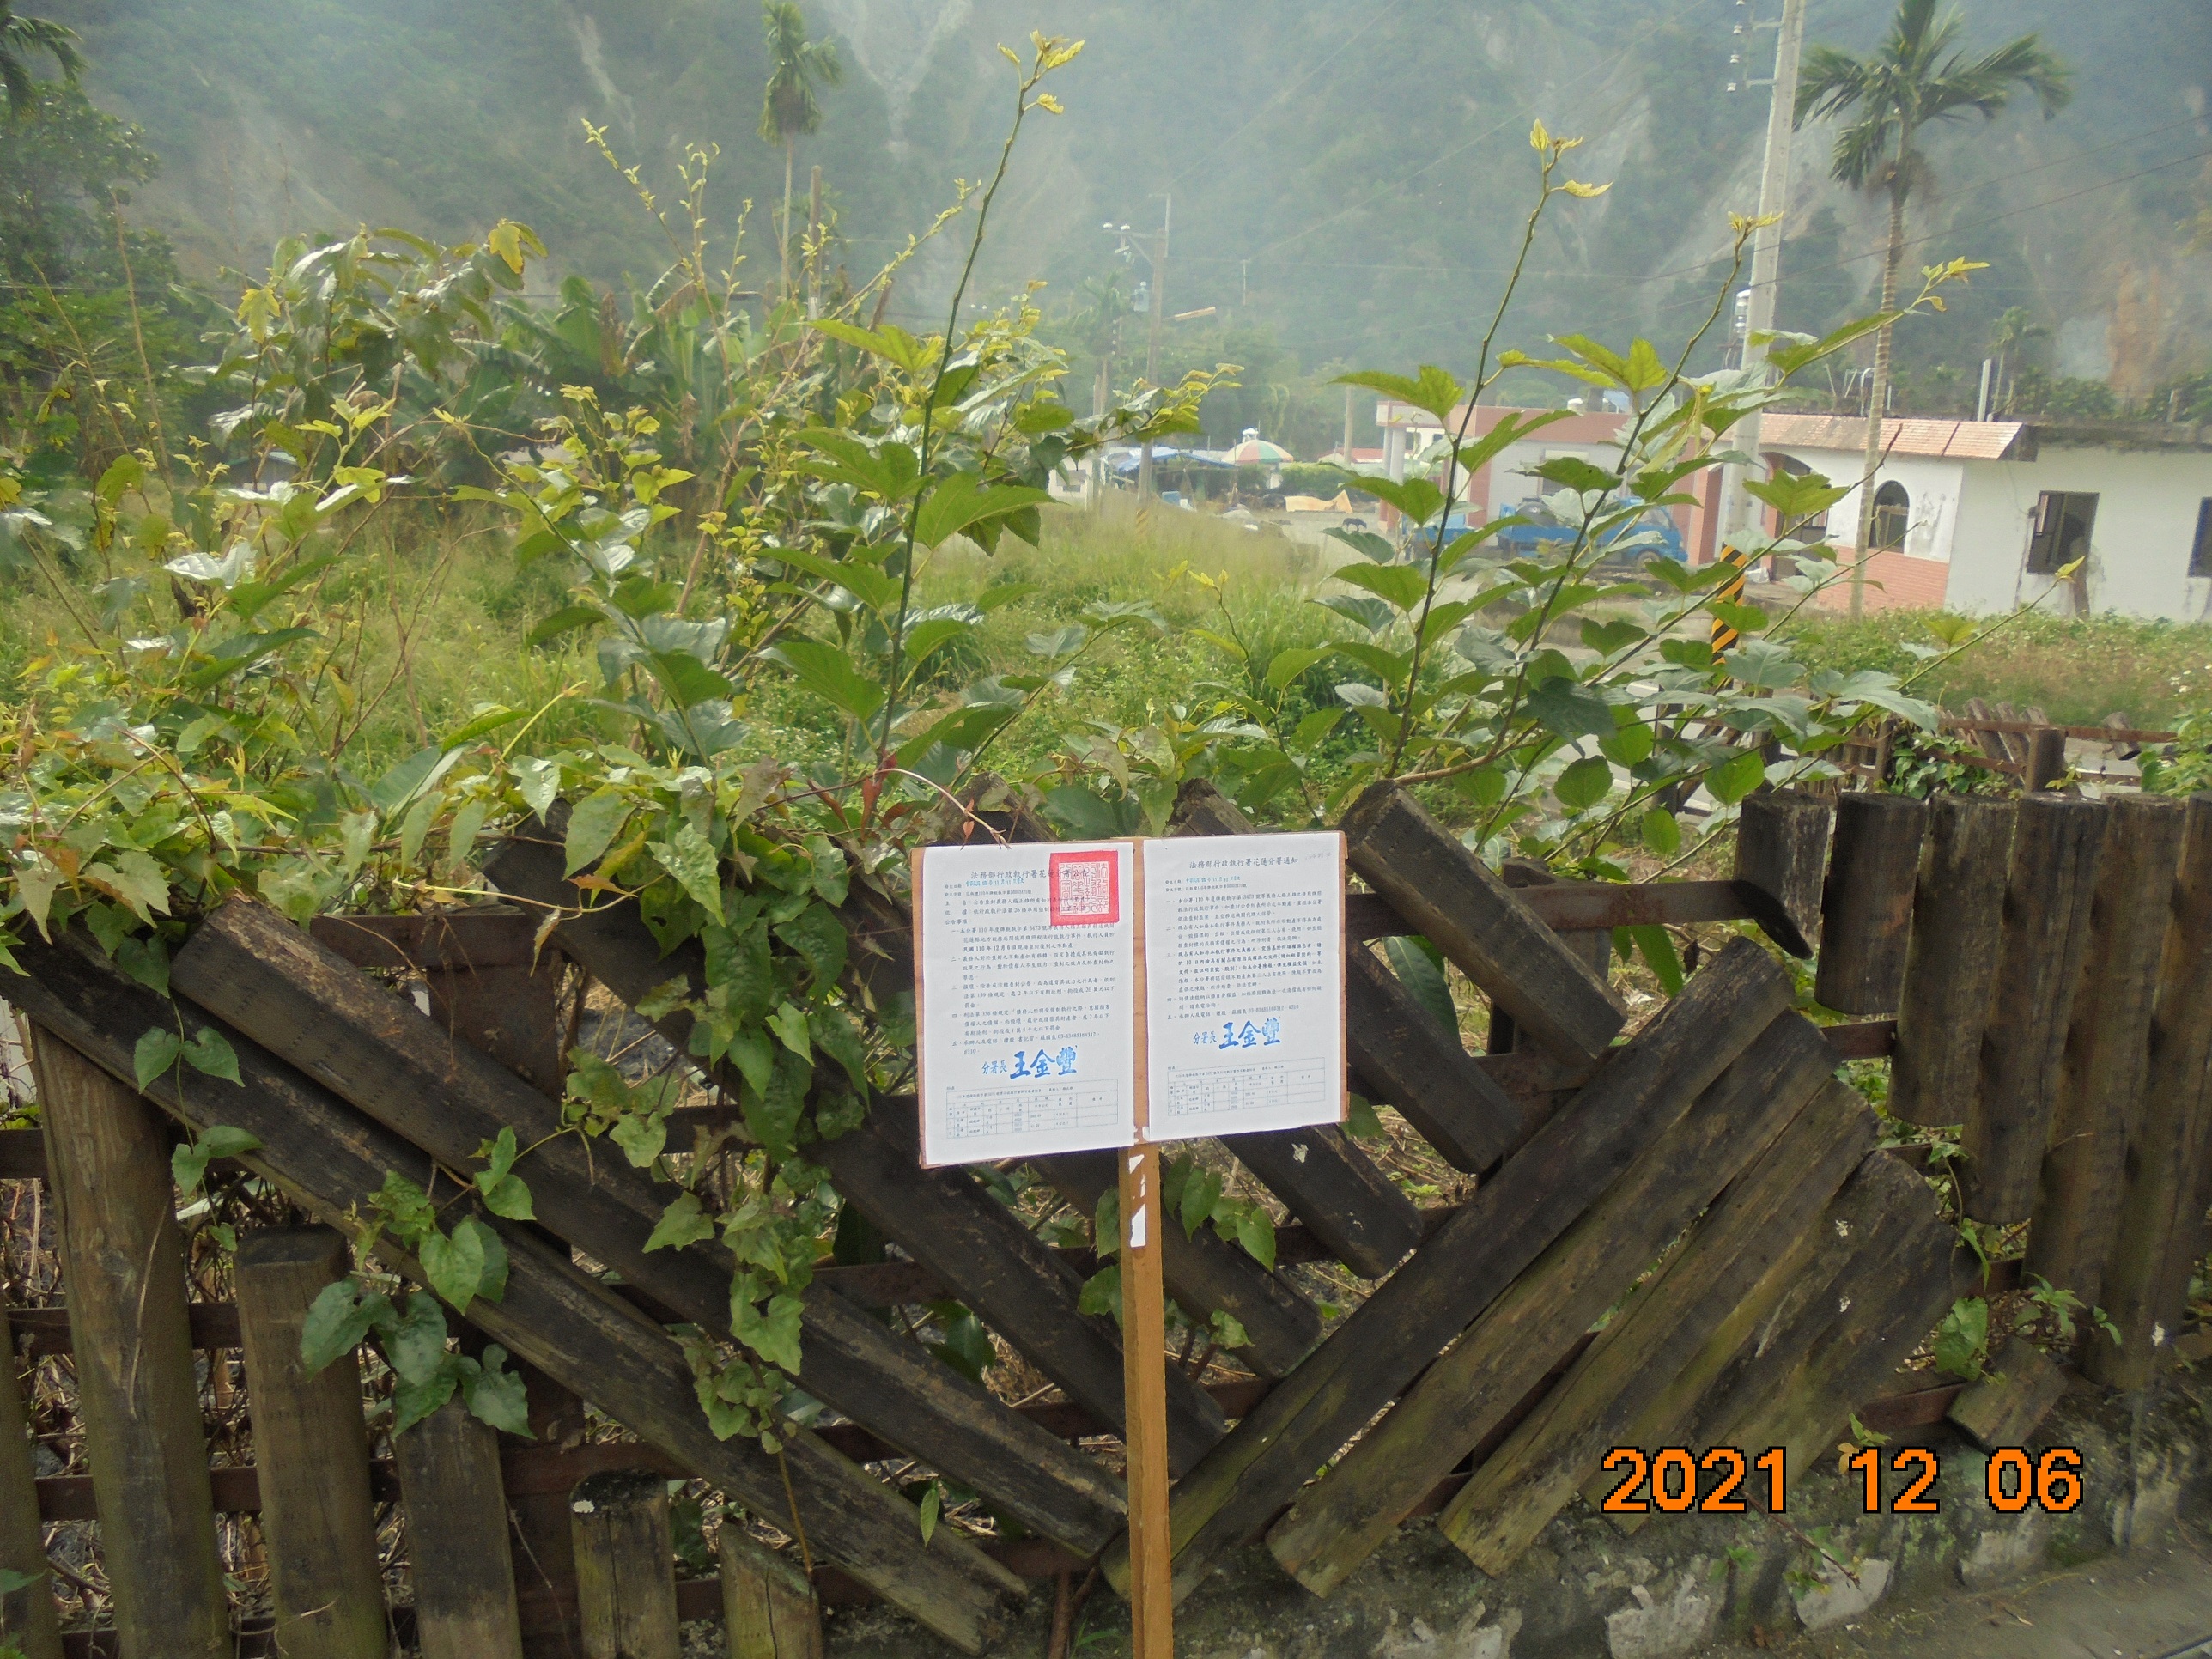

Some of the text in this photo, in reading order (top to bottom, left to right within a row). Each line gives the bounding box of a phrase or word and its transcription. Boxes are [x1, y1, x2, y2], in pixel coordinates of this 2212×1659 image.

[1193, 1017, 1280, 1049] 分署長 王金豐
[982, 1045, 1078, 1080] 分署長 王金豐
